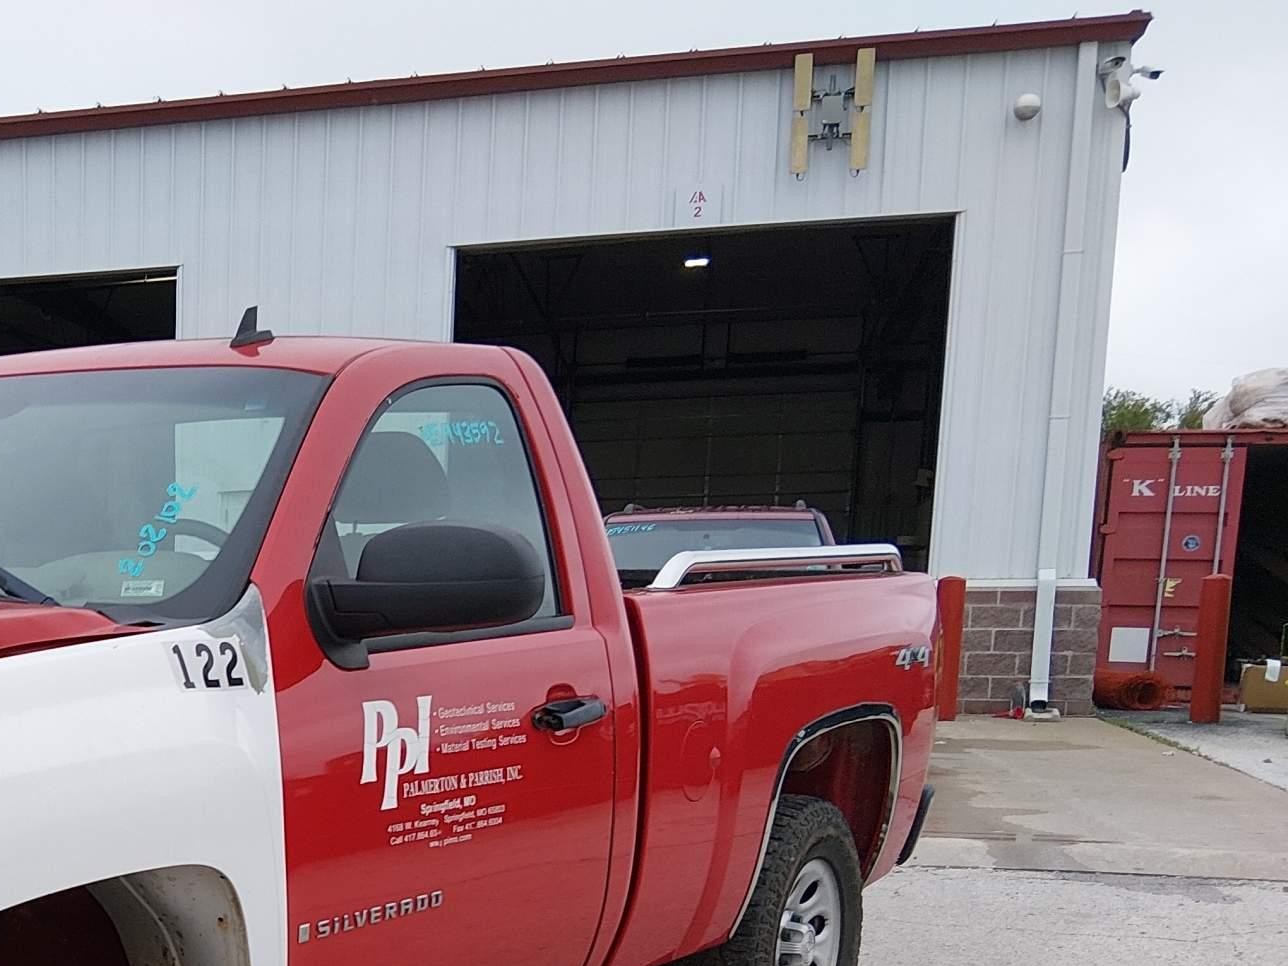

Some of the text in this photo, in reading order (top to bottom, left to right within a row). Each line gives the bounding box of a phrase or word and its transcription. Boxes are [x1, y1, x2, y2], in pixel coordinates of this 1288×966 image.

[693, 206, 702, 218] 2
[1172, 485, 1221, 497] LINE
[172, 642, 244, 689] 122
[438, 701, 516, 719] Geotechnical Services
[440, 718, 521, 736] Environmental Services
[441, 733, 527, 754] Material Testing Services
[402, 776, 458, 798] PALMERTON
[459, 774, 466, 789] &
[315, 890, 443, 939] SILVERADO
